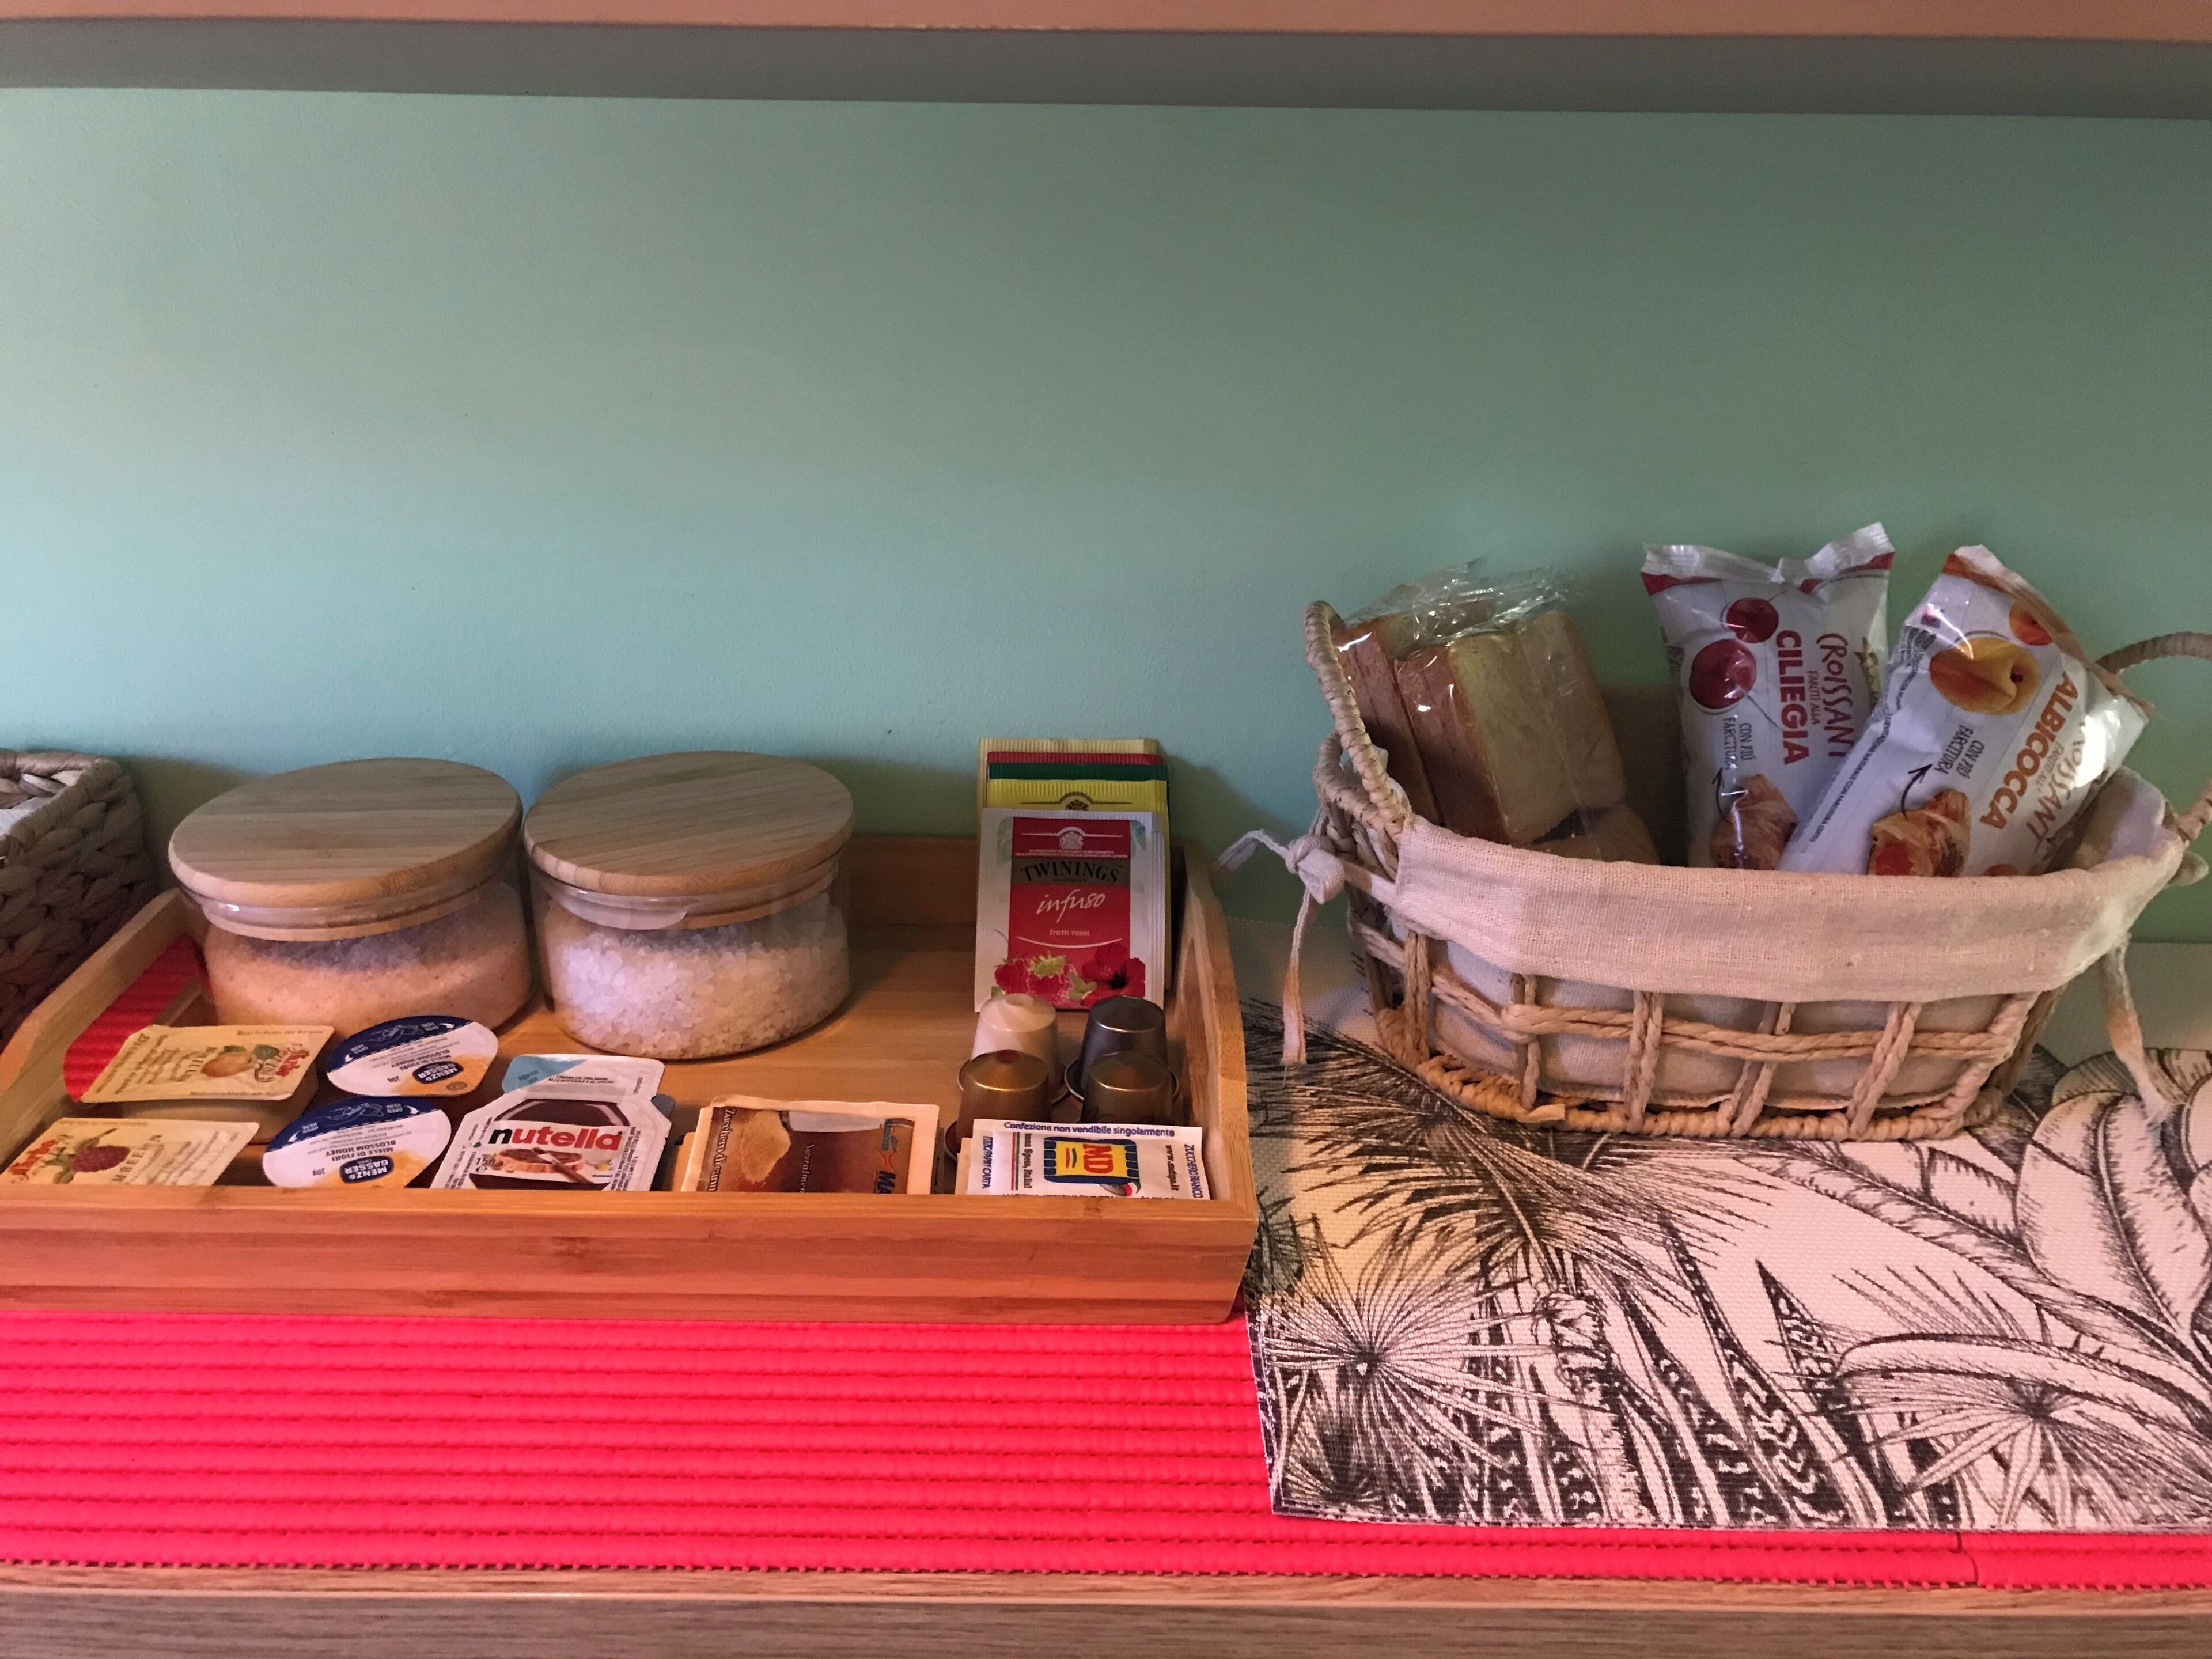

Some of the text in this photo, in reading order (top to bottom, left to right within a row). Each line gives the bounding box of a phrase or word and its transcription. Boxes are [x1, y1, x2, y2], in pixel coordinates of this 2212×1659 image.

[1775, 630, 1809, 765] CILIEGIA
[1809, 703, 1820, 725] ALLA
[1739, 722, 1752, 741] CON
[1934, 724, 1973, 775] FARCITURA
[1971, 740, 1984, 759] CON
[1979, 671, 2078, 828] ALBICOCCA
[1020, 862, 1120, 884] TWININGS
[1036, 889, 1106, 922] infuso
[1050, 929, 1090, 937] frutti rossi
[488, 1126, 623, 1150] nutella
[717, 1108, 736, 1153] Zucchero
[1004, 1122, 1052, 1131] Confezione
[1071, 1124, 1111, 1134] vendibile
[1113, 1126, 1175, 1137] singolarmente
[325, 1139, 396, 1157] BLOSSOM HONEY
[331, 1152, 355, 1162] FIORI
[716, 1153, 727, 1164] di
[1022, 1148, 1033, 1168] Spesa,
[1083, 1143, 1113, 1173] MD
[344, 1159, 389, 1175] GASSER
[982, 1167, 993, 1189] CARTA
[1184, 1144, 1203, 1199] ZUCCHERO BIANCO
